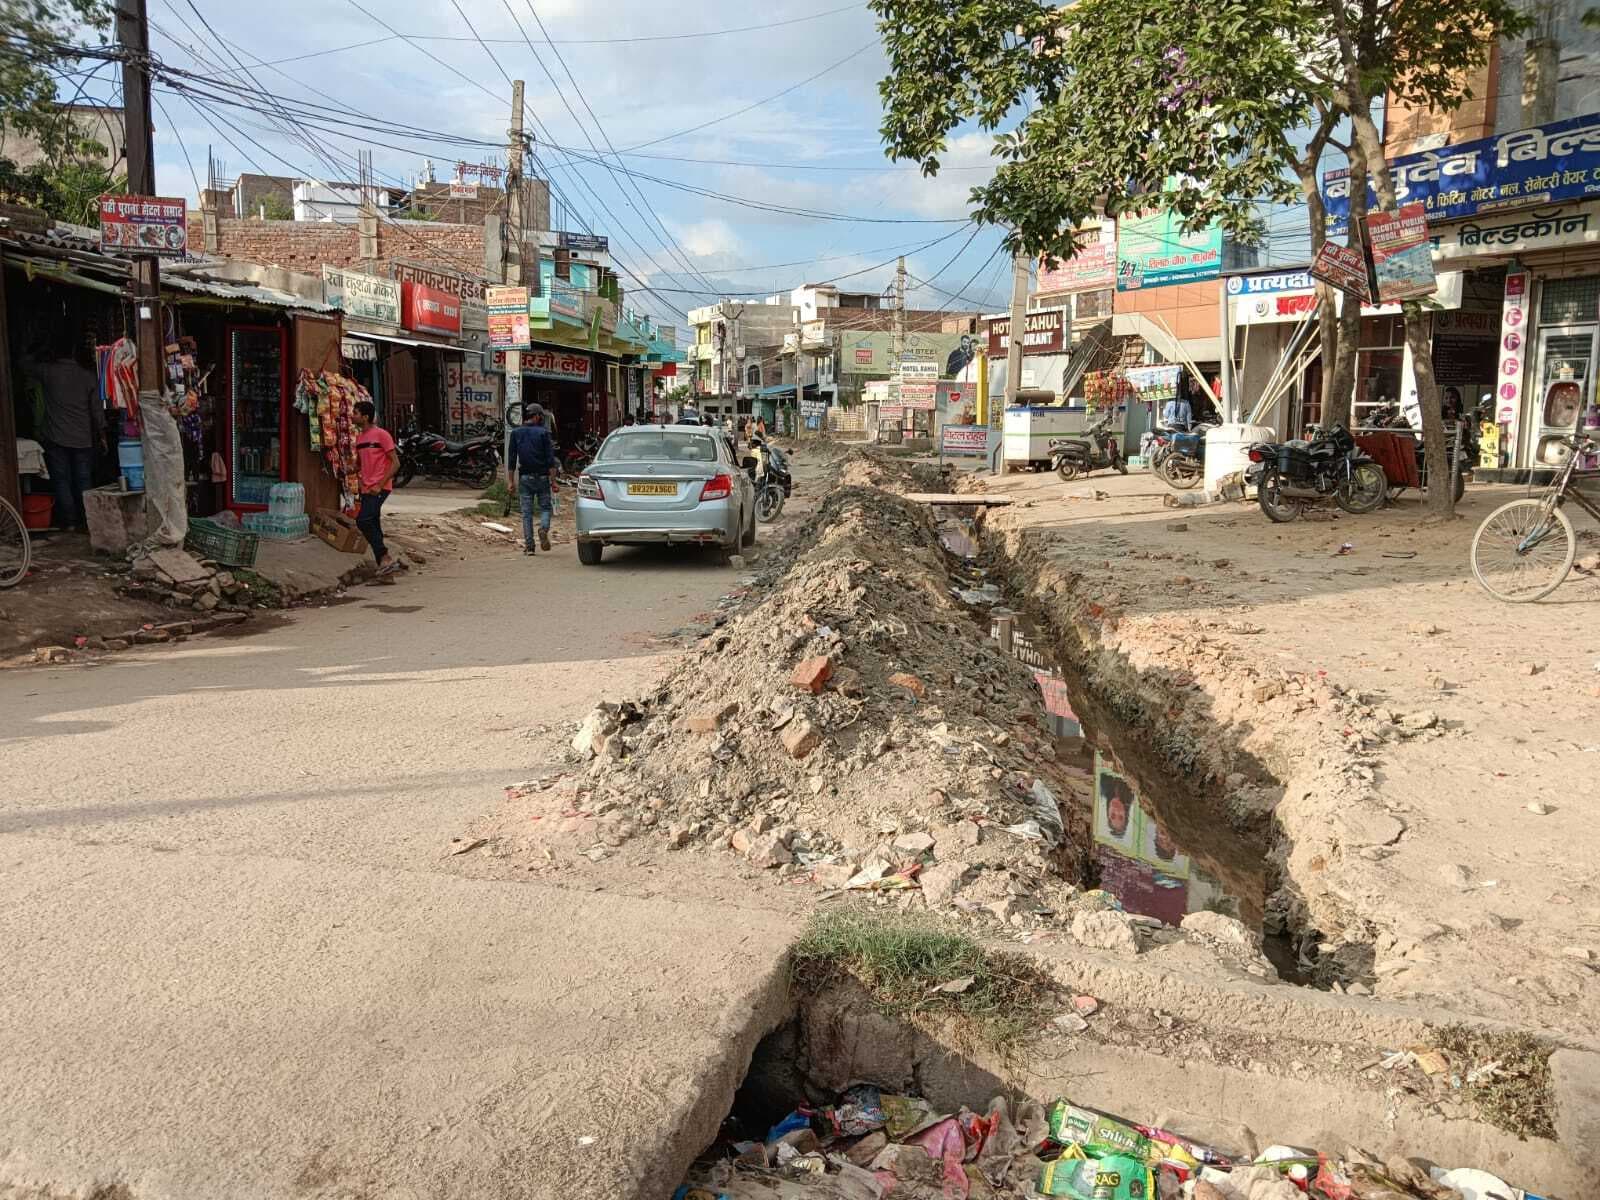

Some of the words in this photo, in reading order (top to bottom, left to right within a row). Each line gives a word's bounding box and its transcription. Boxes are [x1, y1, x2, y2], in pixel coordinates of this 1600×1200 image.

[1426, 195, 1434, 209] &
[1369, 222, 1400, 236] CALCUTTA
[1401, 216, 1425, 229] PUBLIC
[1456, 208, 1592, 247] बिल्डकॉन
[1024, 313, 1061, 333] RAHUL
[1000, 331, 1055, 348] REURANT
